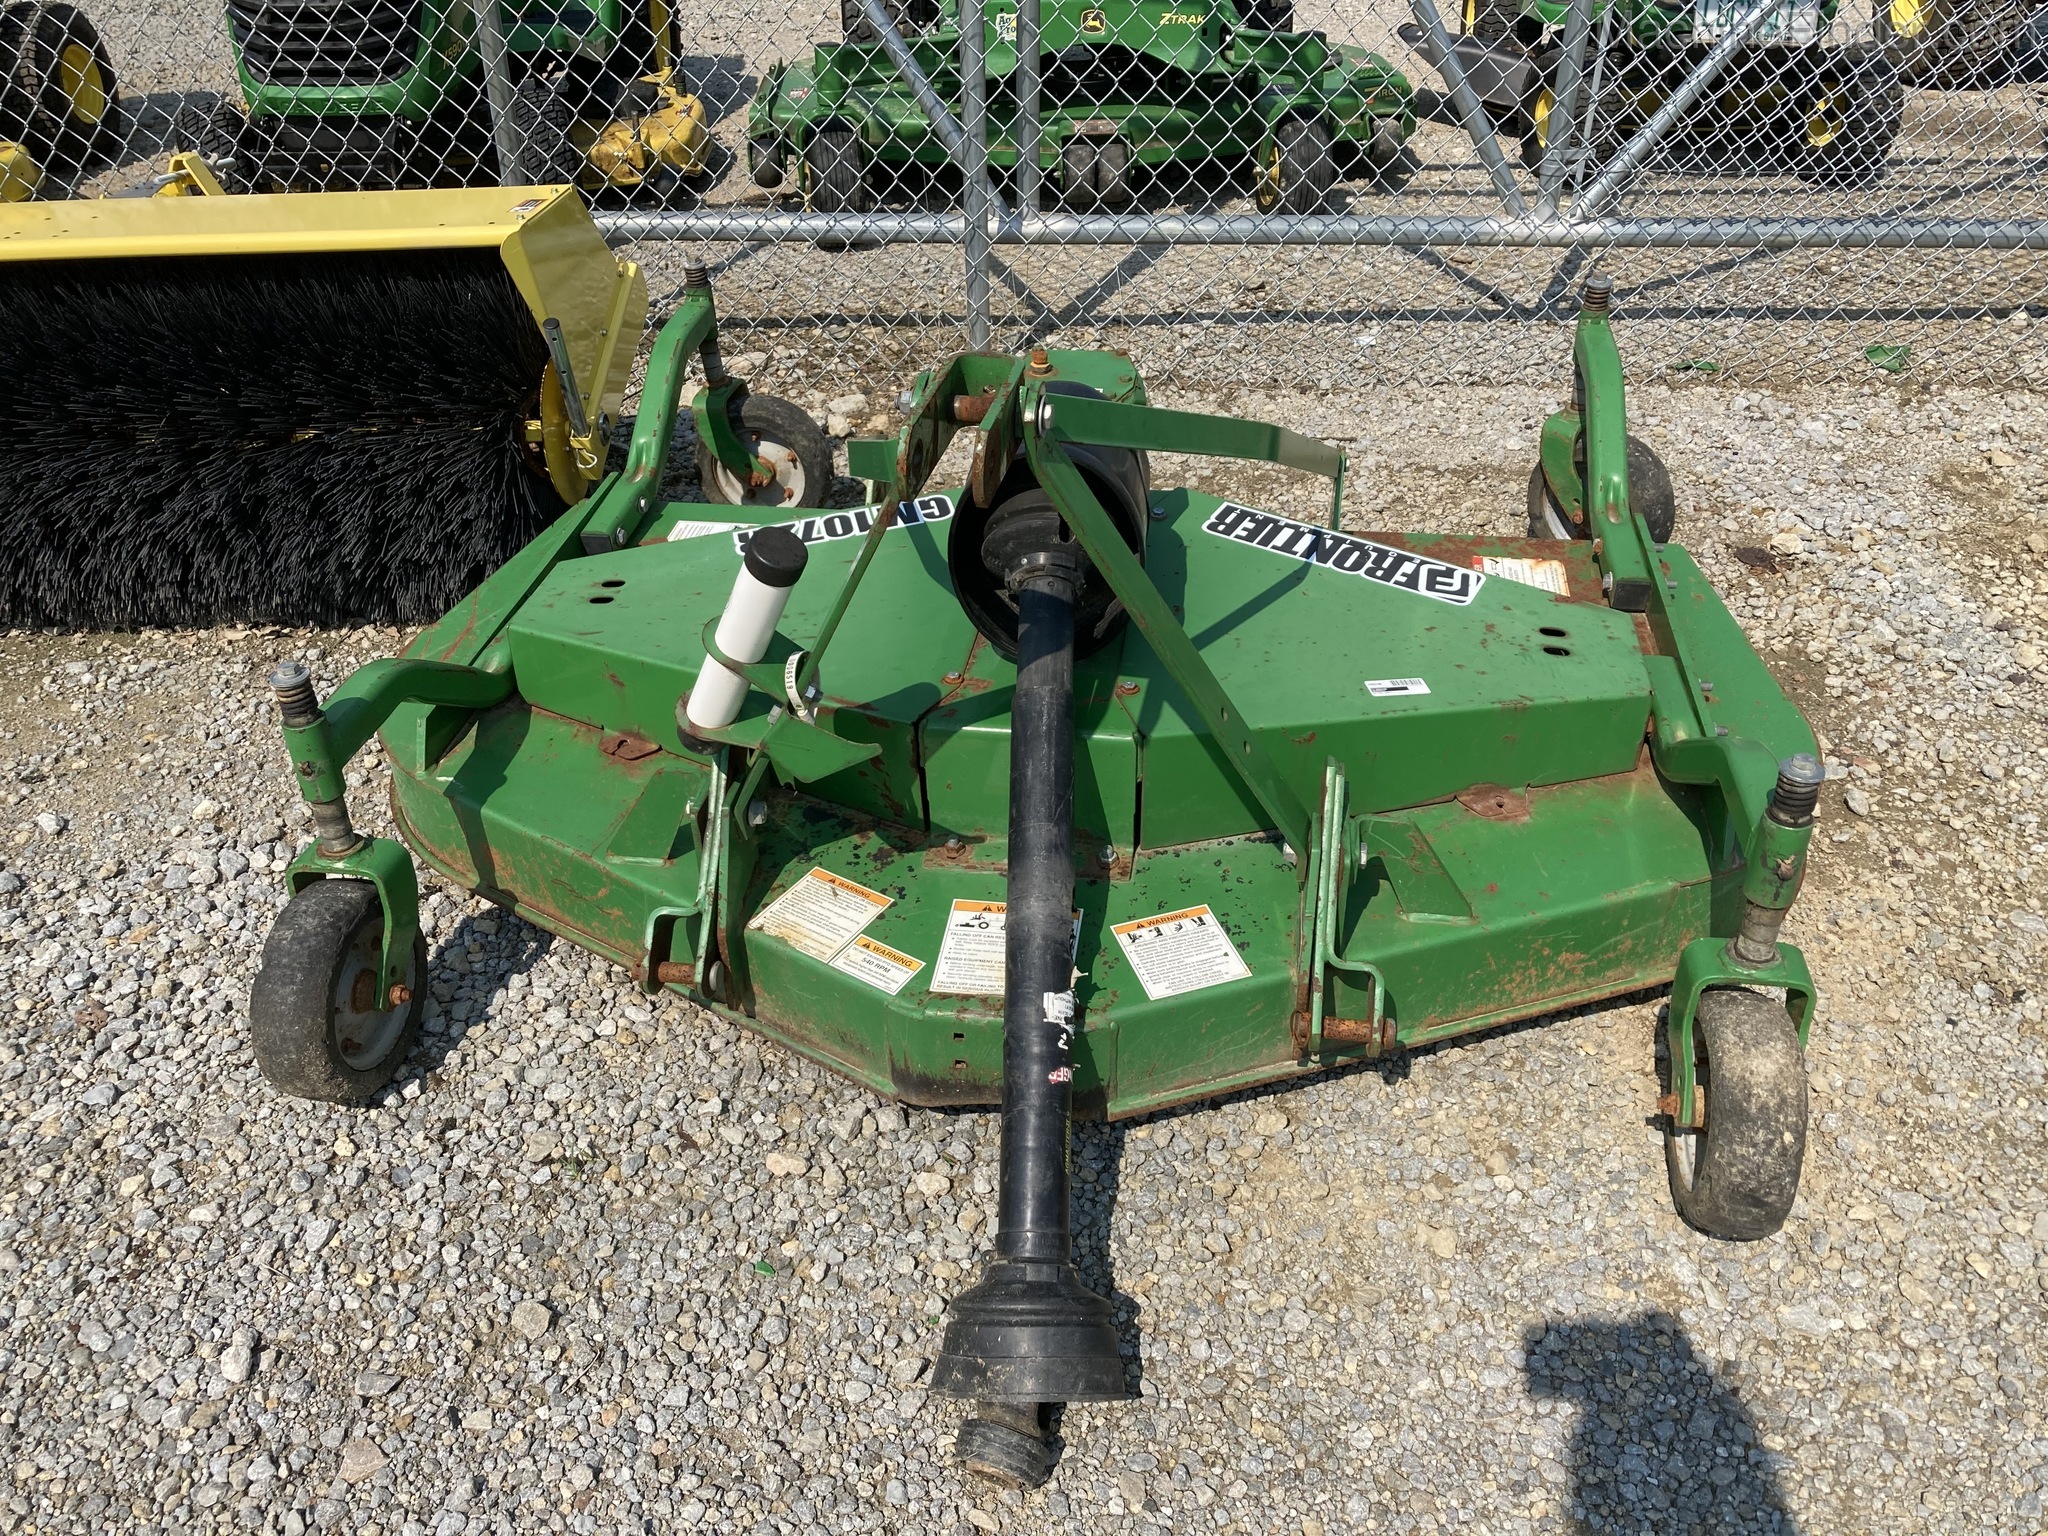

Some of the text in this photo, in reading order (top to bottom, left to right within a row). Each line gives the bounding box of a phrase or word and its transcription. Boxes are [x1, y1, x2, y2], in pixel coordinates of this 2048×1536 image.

[1233, 508, 1420, 565] EQUIPMENT
[1207, 505, 1428, 591] FRONTIER
[836, 881, 871, 898] WARNING
[1146, 912, 1188, 926] WARNING
[860, 957, 891, 973] 540 RPM
[871, 945, 913, 967] WARNING
